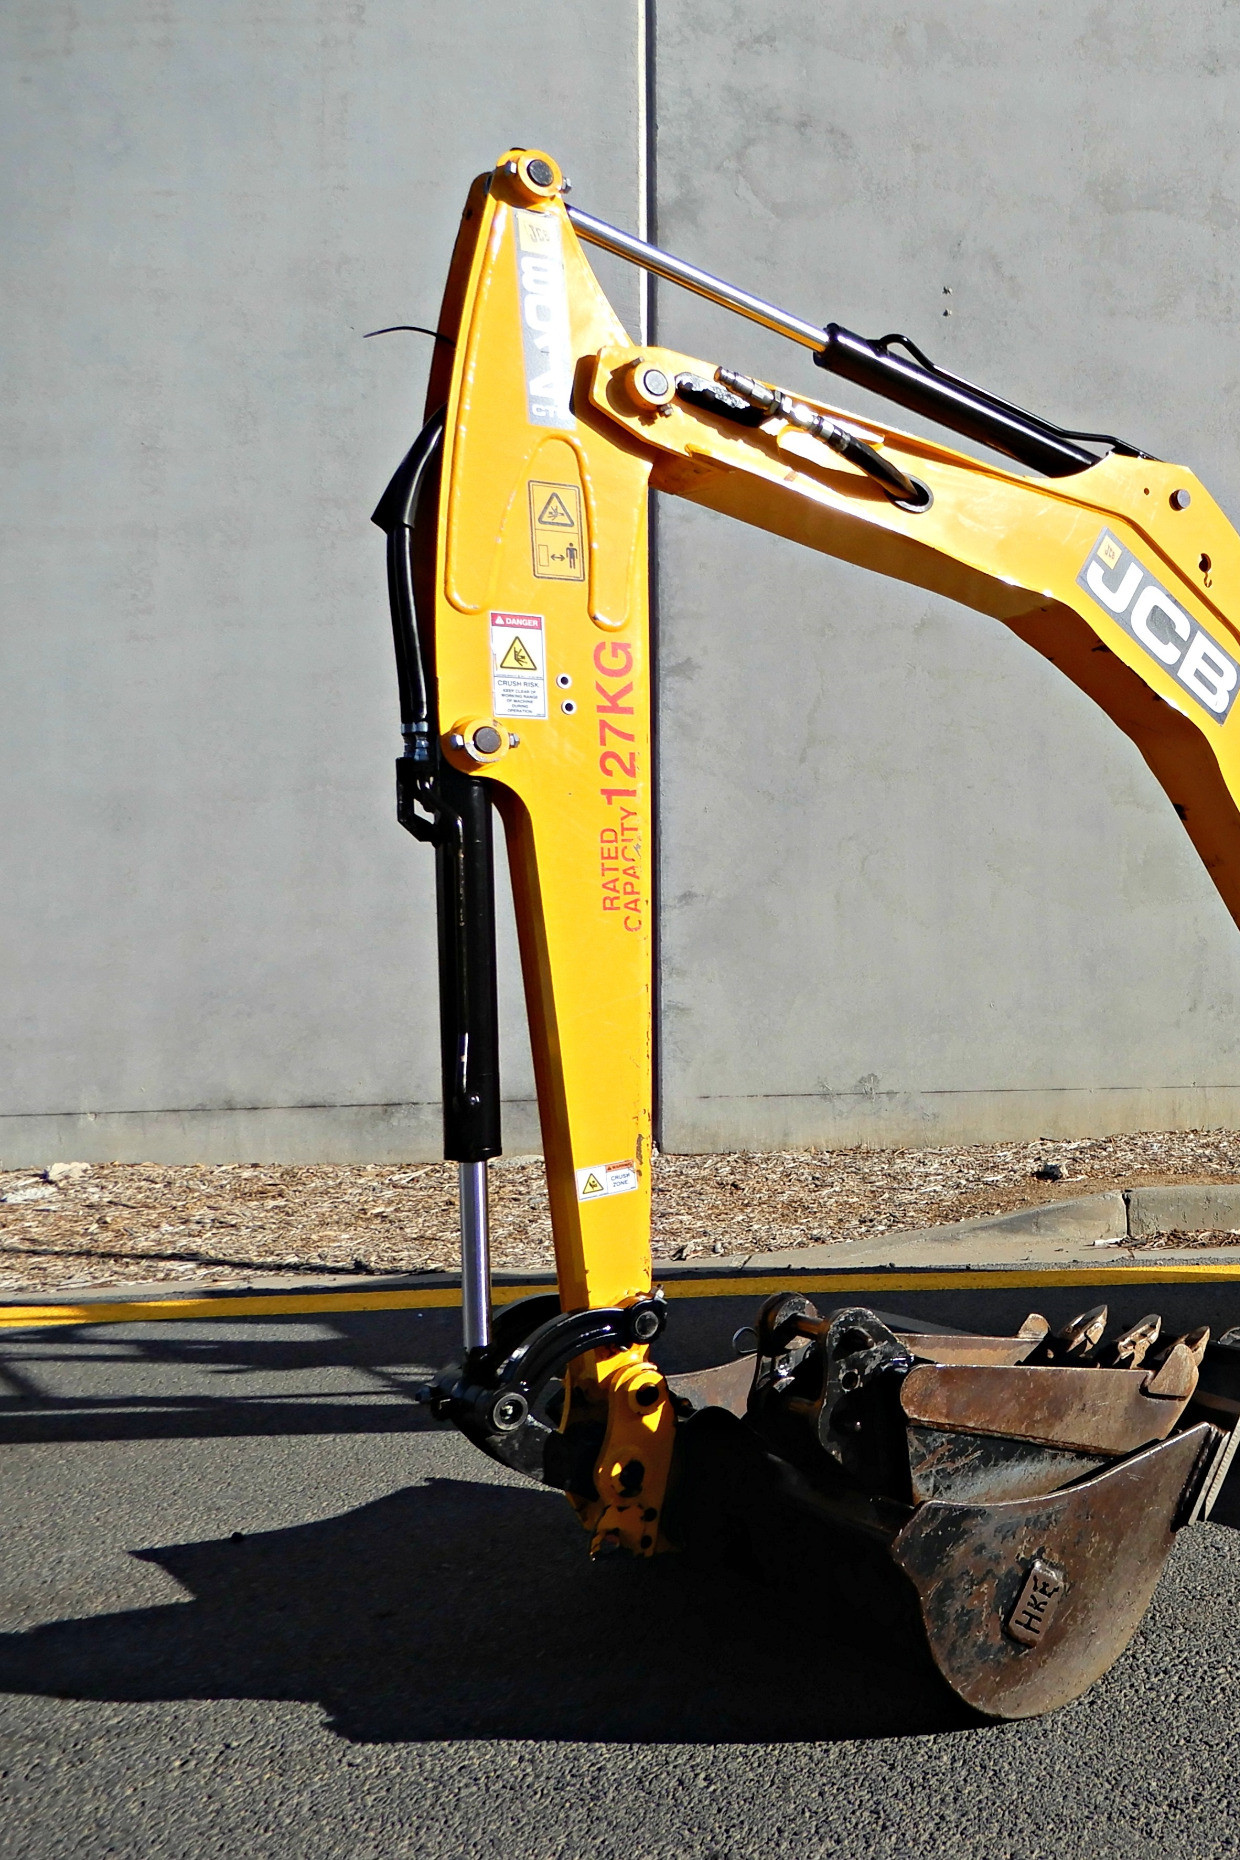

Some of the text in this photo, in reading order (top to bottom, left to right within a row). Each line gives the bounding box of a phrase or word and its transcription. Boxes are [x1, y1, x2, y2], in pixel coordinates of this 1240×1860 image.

[505, 617, 539, 627] DANGER
[1086, 560, 1238, 714] JCB
[497, 679, 522, 687] CRUSH
[593, 641, 637, 806] 127KG
[600, 827, 620, 911] RATED
[620, 806, 642, 933] CAPACITY
[611, 1173, 630, 1181] CRUSH
